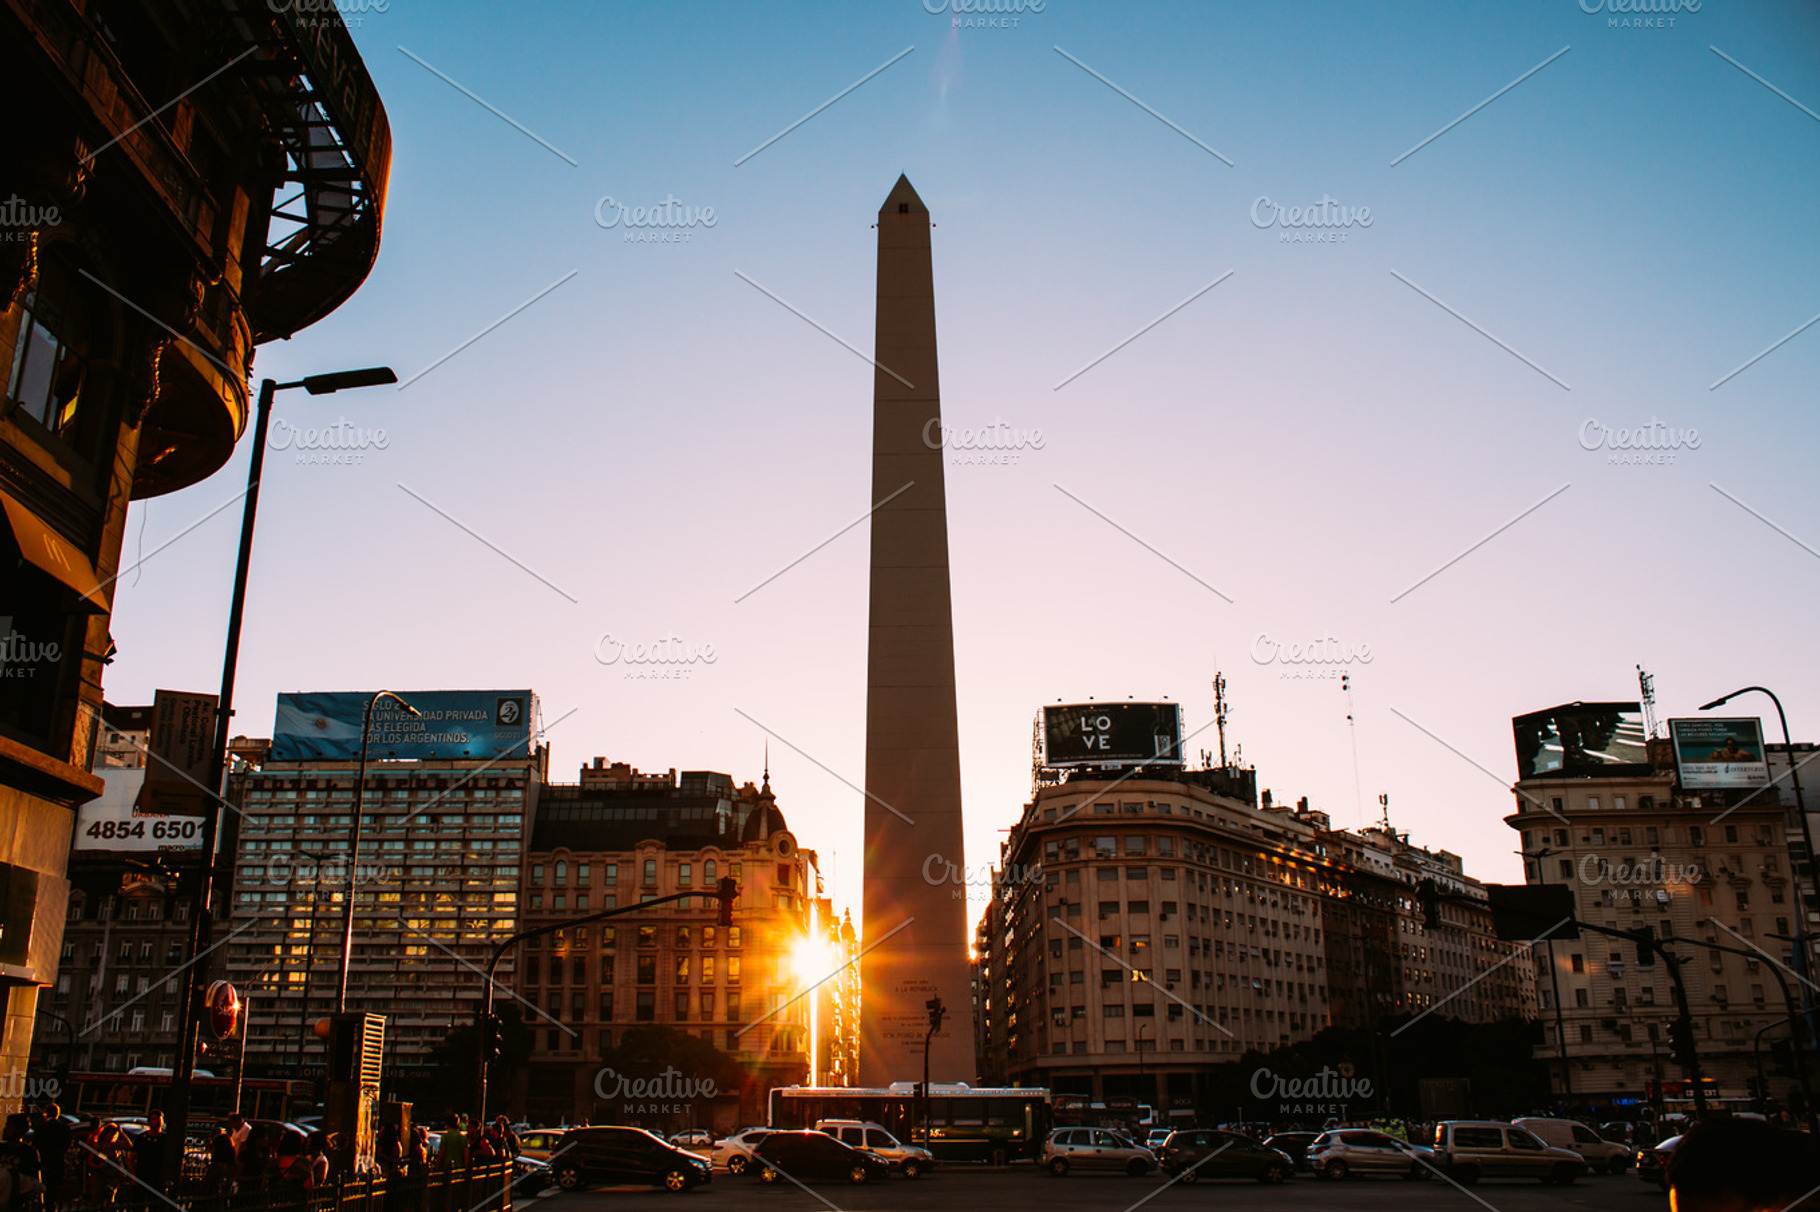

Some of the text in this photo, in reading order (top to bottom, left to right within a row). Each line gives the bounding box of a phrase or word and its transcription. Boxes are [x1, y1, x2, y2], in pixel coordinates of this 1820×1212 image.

[446, 710, 488, 720] PRIVADA
[384, 722, 426, 732] ELEGIDA
[382, 733, 402, 743] LOS
[403, 733, 469, 743] ARGENTINOS.
[86, 820, 145, 839] 4854
